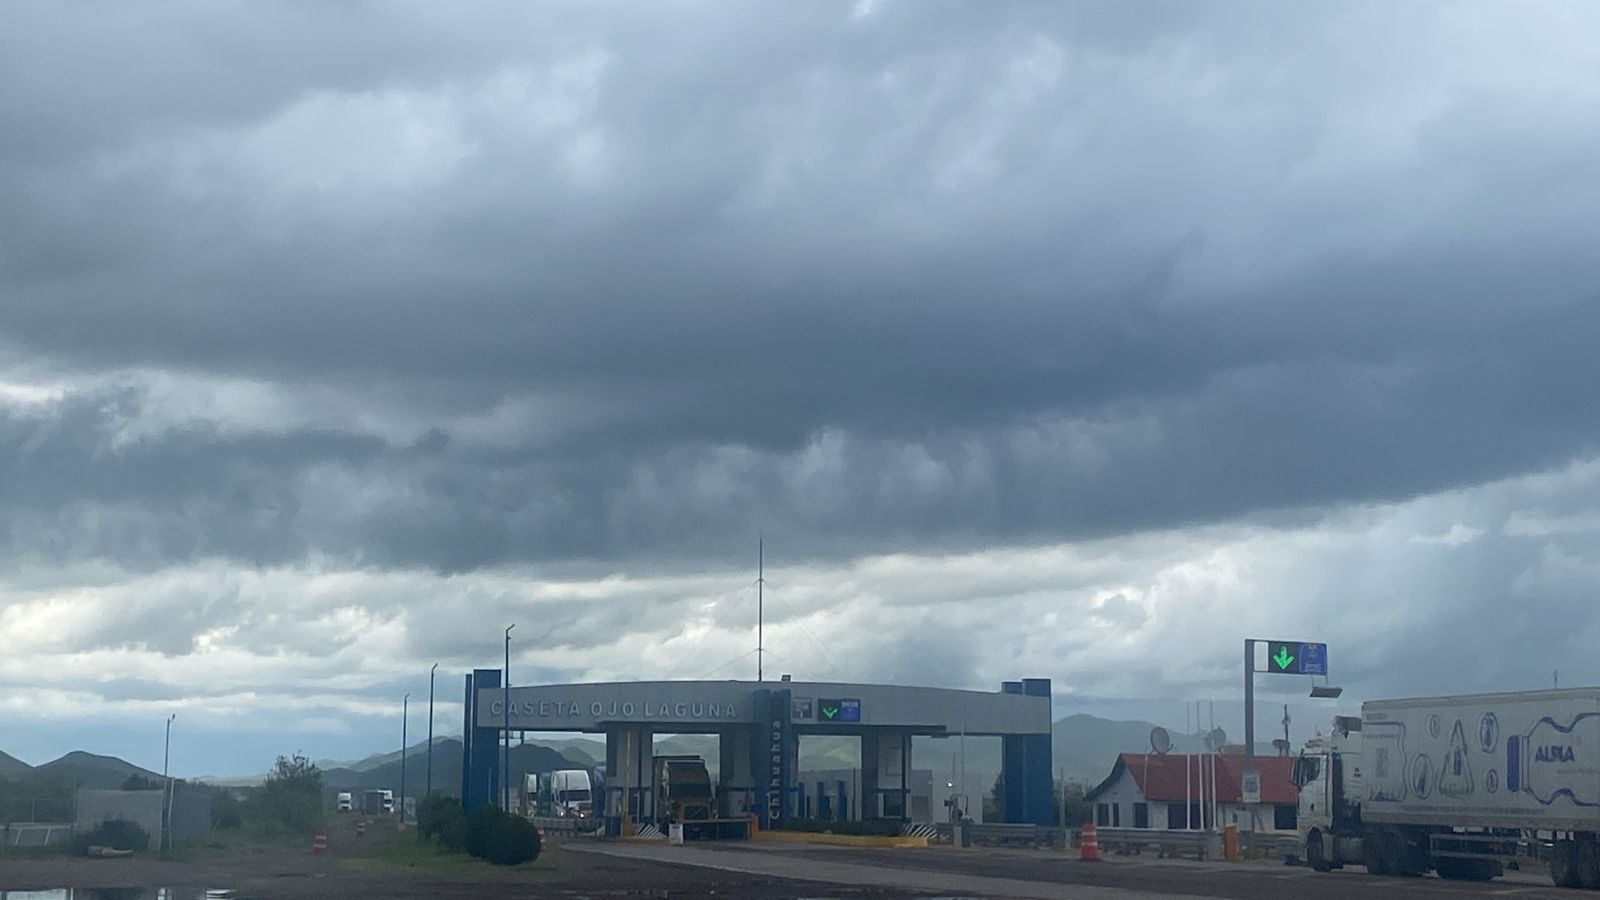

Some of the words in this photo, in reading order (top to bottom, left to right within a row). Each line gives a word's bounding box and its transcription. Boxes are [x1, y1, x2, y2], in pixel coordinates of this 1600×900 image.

[491, 702, 580, 717] CASETA
[590, 702, 635, 718] OJO
[645, 702, 738, 719] LAGUNA
[769, 720, 782, 820] Chihuahua
